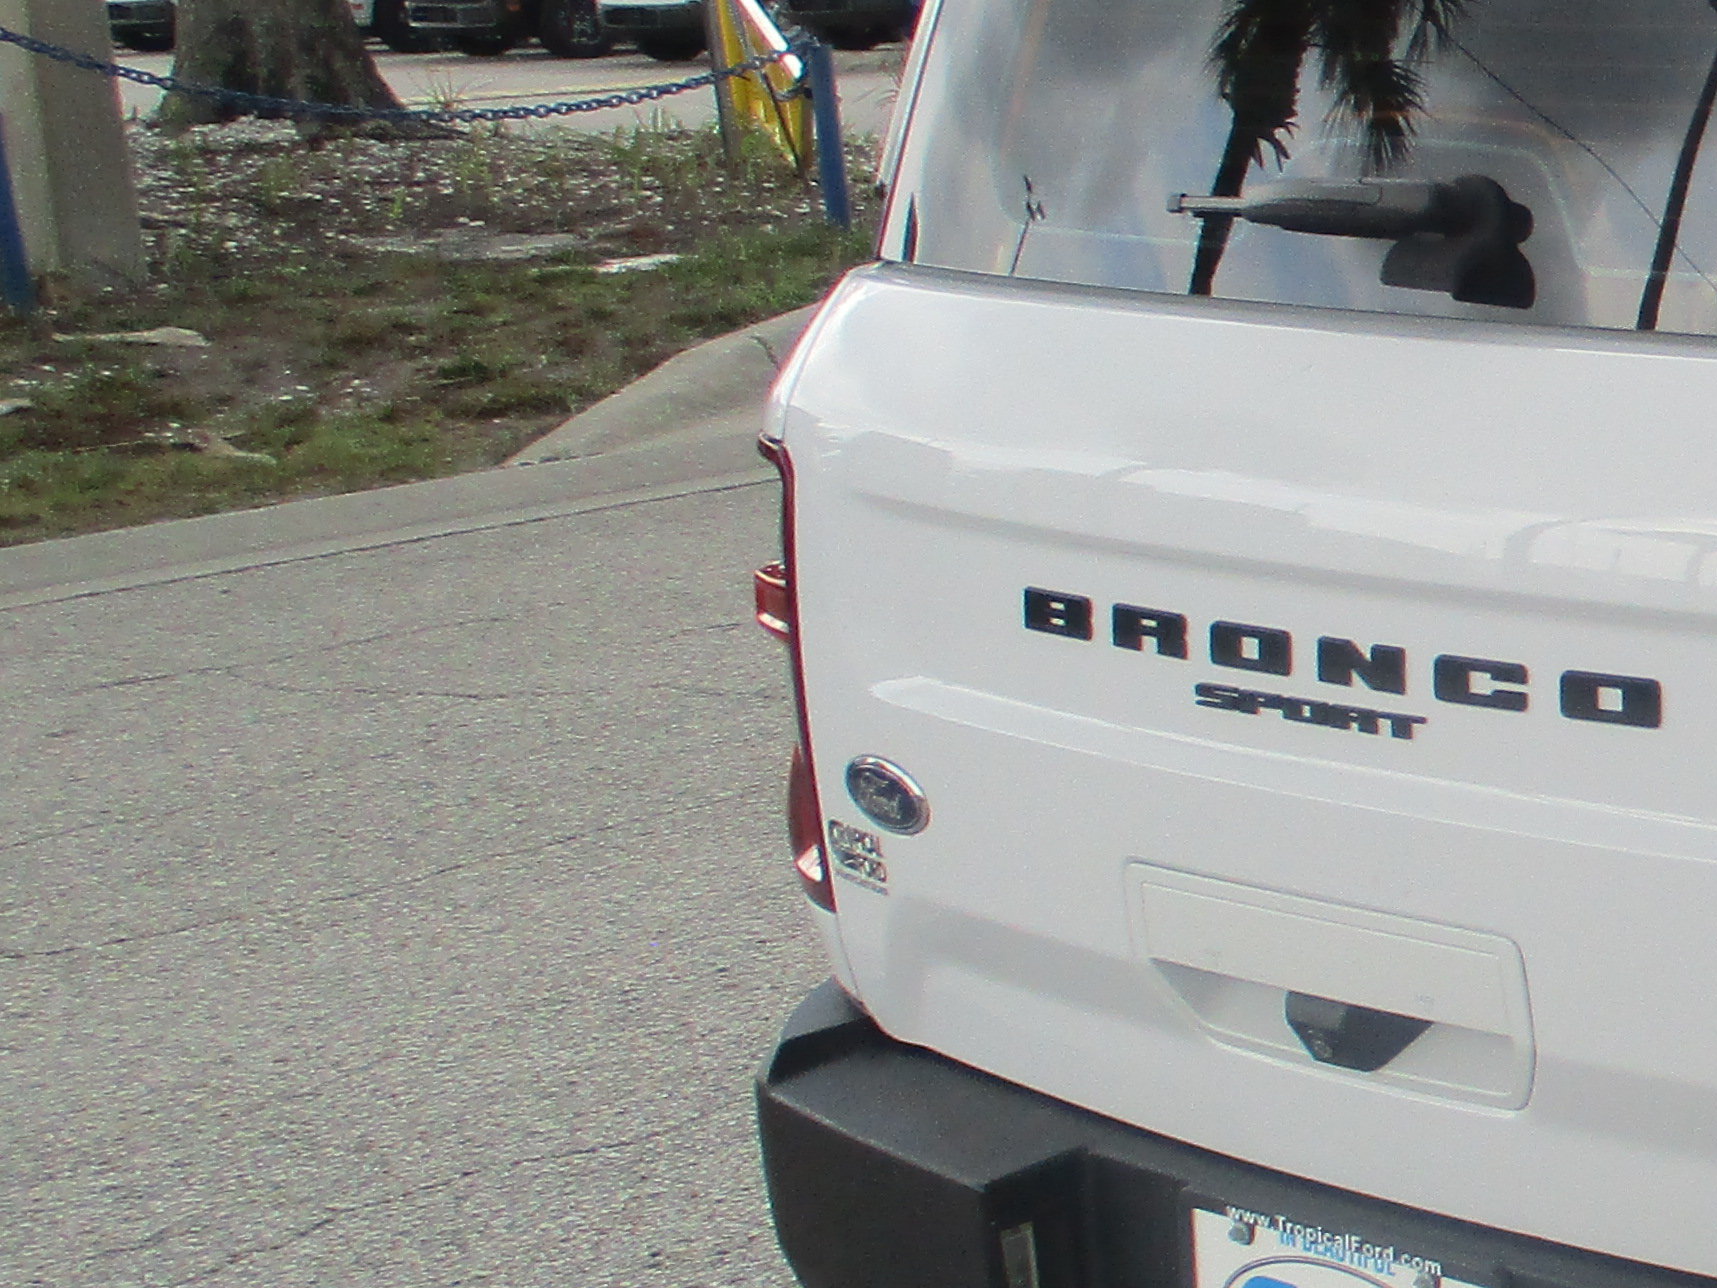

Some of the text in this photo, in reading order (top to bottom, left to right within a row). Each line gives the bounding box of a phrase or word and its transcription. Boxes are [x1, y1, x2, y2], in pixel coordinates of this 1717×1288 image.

[1023, 585, 1663, 729] BRONCO
[1194, 681, 1428, 741] SPORT
[1226, 1205, 1442, 1276] www.TropicalFord.com
